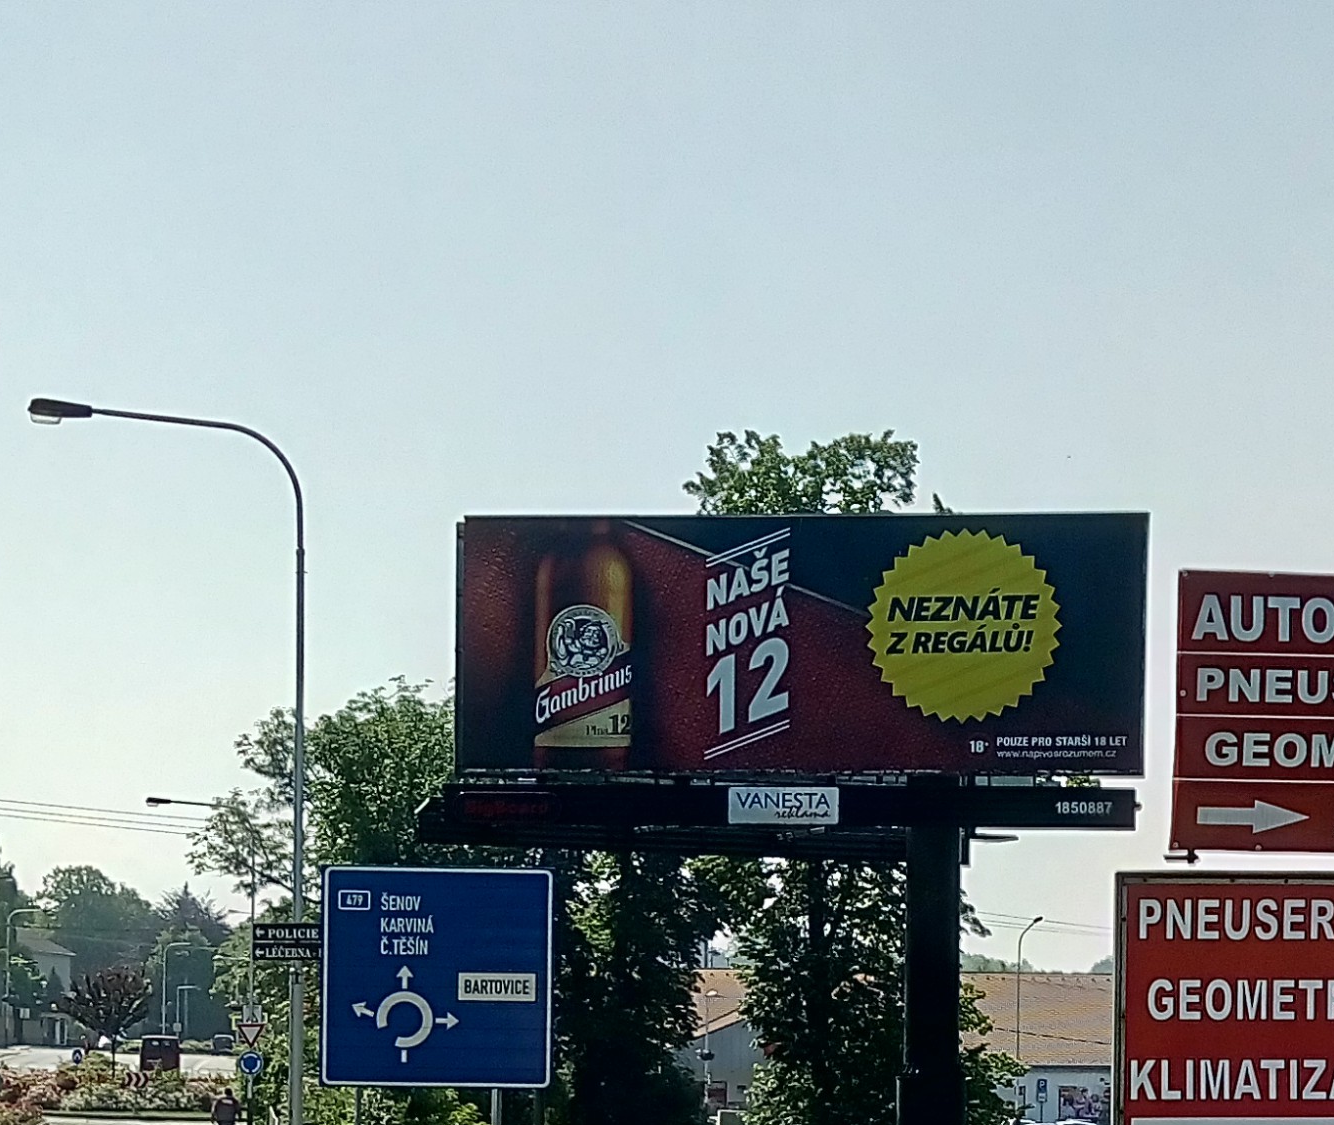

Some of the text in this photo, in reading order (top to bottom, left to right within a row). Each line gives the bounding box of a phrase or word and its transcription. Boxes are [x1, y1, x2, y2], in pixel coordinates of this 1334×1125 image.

[706, 547, 790, 611] NAŠE
[887, 587, 1040, 622] NEZNÁTE
[706, 585, 790, 657] NOVÁ
[886, 623, 1034, 655] Z REGÁLŮ!
[535, 665, 633, 725] Gambrinus
[706, 637, 790, 735] 12
[609, 713, 631, 735] 12
[996, 735, 1128, 747] POUZE PRO STARŠÍ 18 LET
[735, 792, 831, 809] VANESTA
[1054, 801, 1113, 815] 1850887
[774, 805, 831, 819] reklama
[346, 894, 364, 906] 479
[380, 892, 421, 911] ŠENOV
[267, 928, 319, 939] POLICIE
[380, 914, 435, 934] KARVINÁ
[265, 945, 312, 958] LÉČEBNA
[380, 935, 429, 956] Č.TĚŠÍN
[464, 979, 530, 995] BARTOVICE
